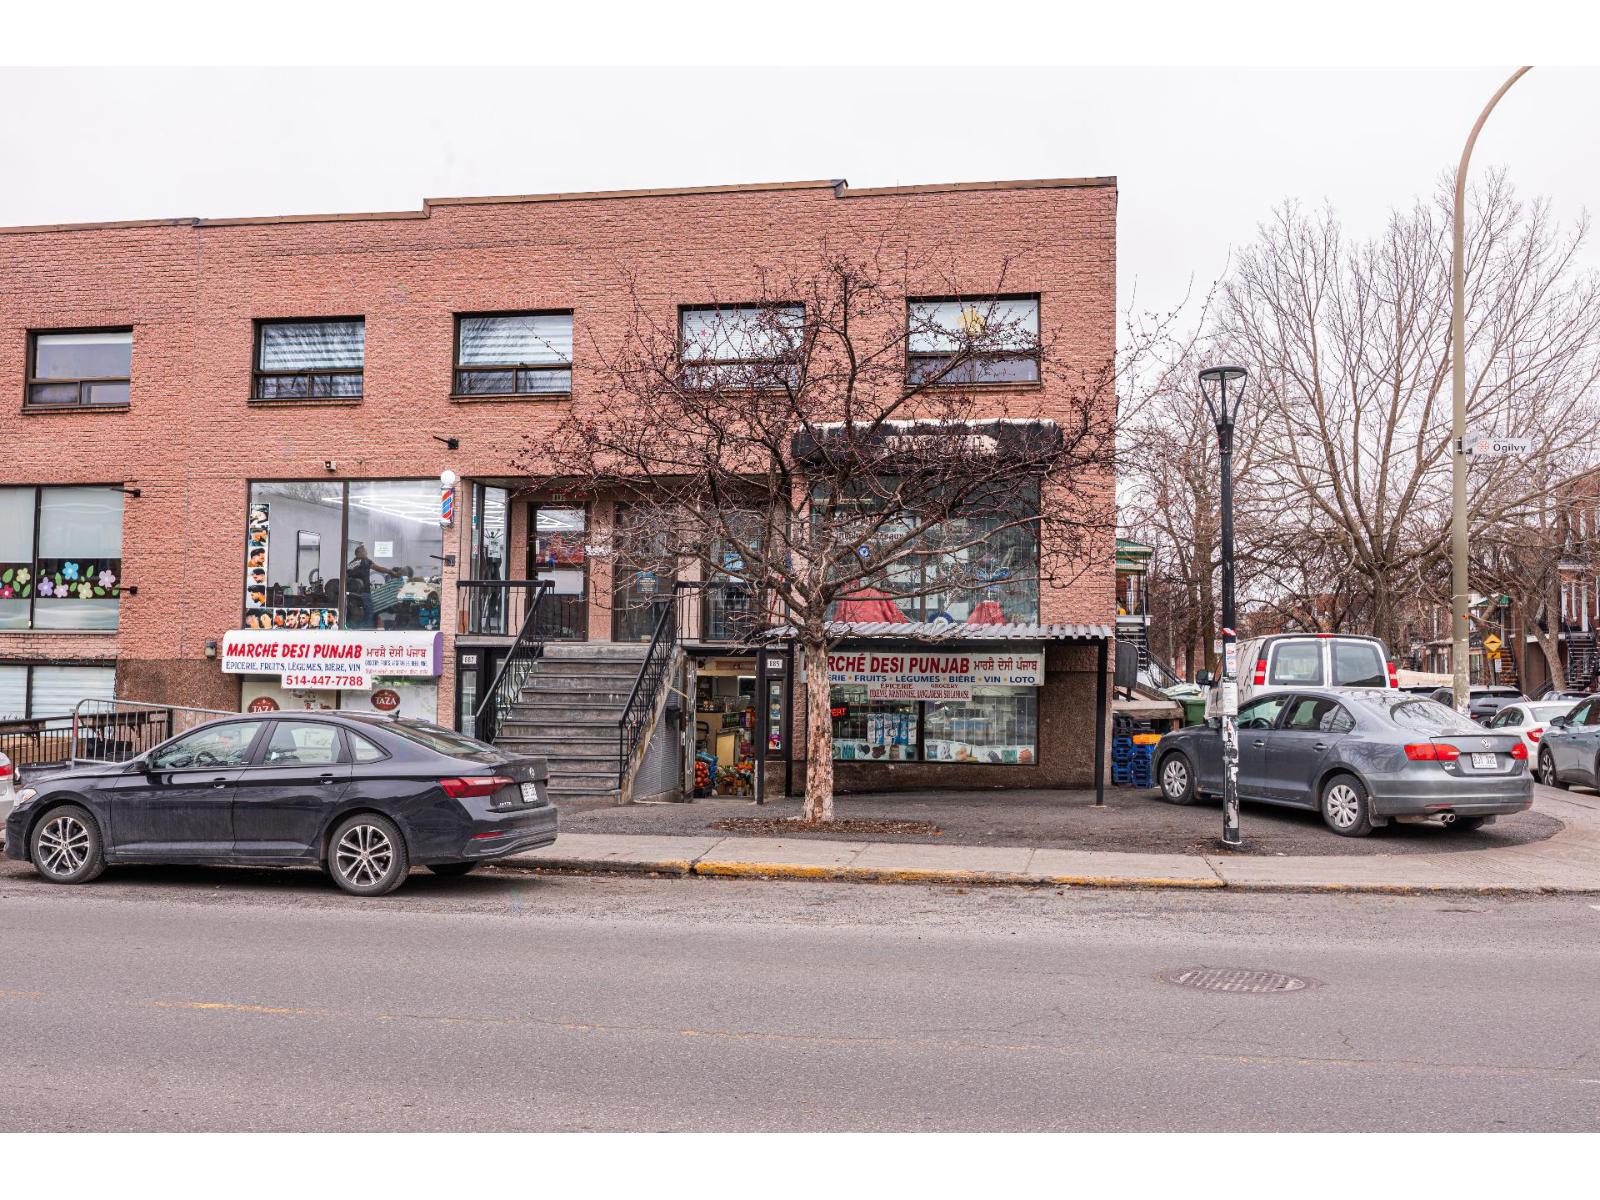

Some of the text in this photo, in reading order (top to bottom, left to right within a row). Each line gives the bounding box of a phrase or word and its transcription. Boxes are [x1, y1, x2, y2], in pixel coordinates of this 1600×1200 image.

[1493, 443, 1526, 453] Ogilvy
[226, 641, 362, 659] MARCHÉ DESI PUNJAB
[803, 652, 969, 673] RCHÉ DESI PUNJAB
[286, 675, 363, 686] 514-447-7788
[895, 674, 940, 683] LÉGUMES
[376, 696, 396, 705] TAZA
